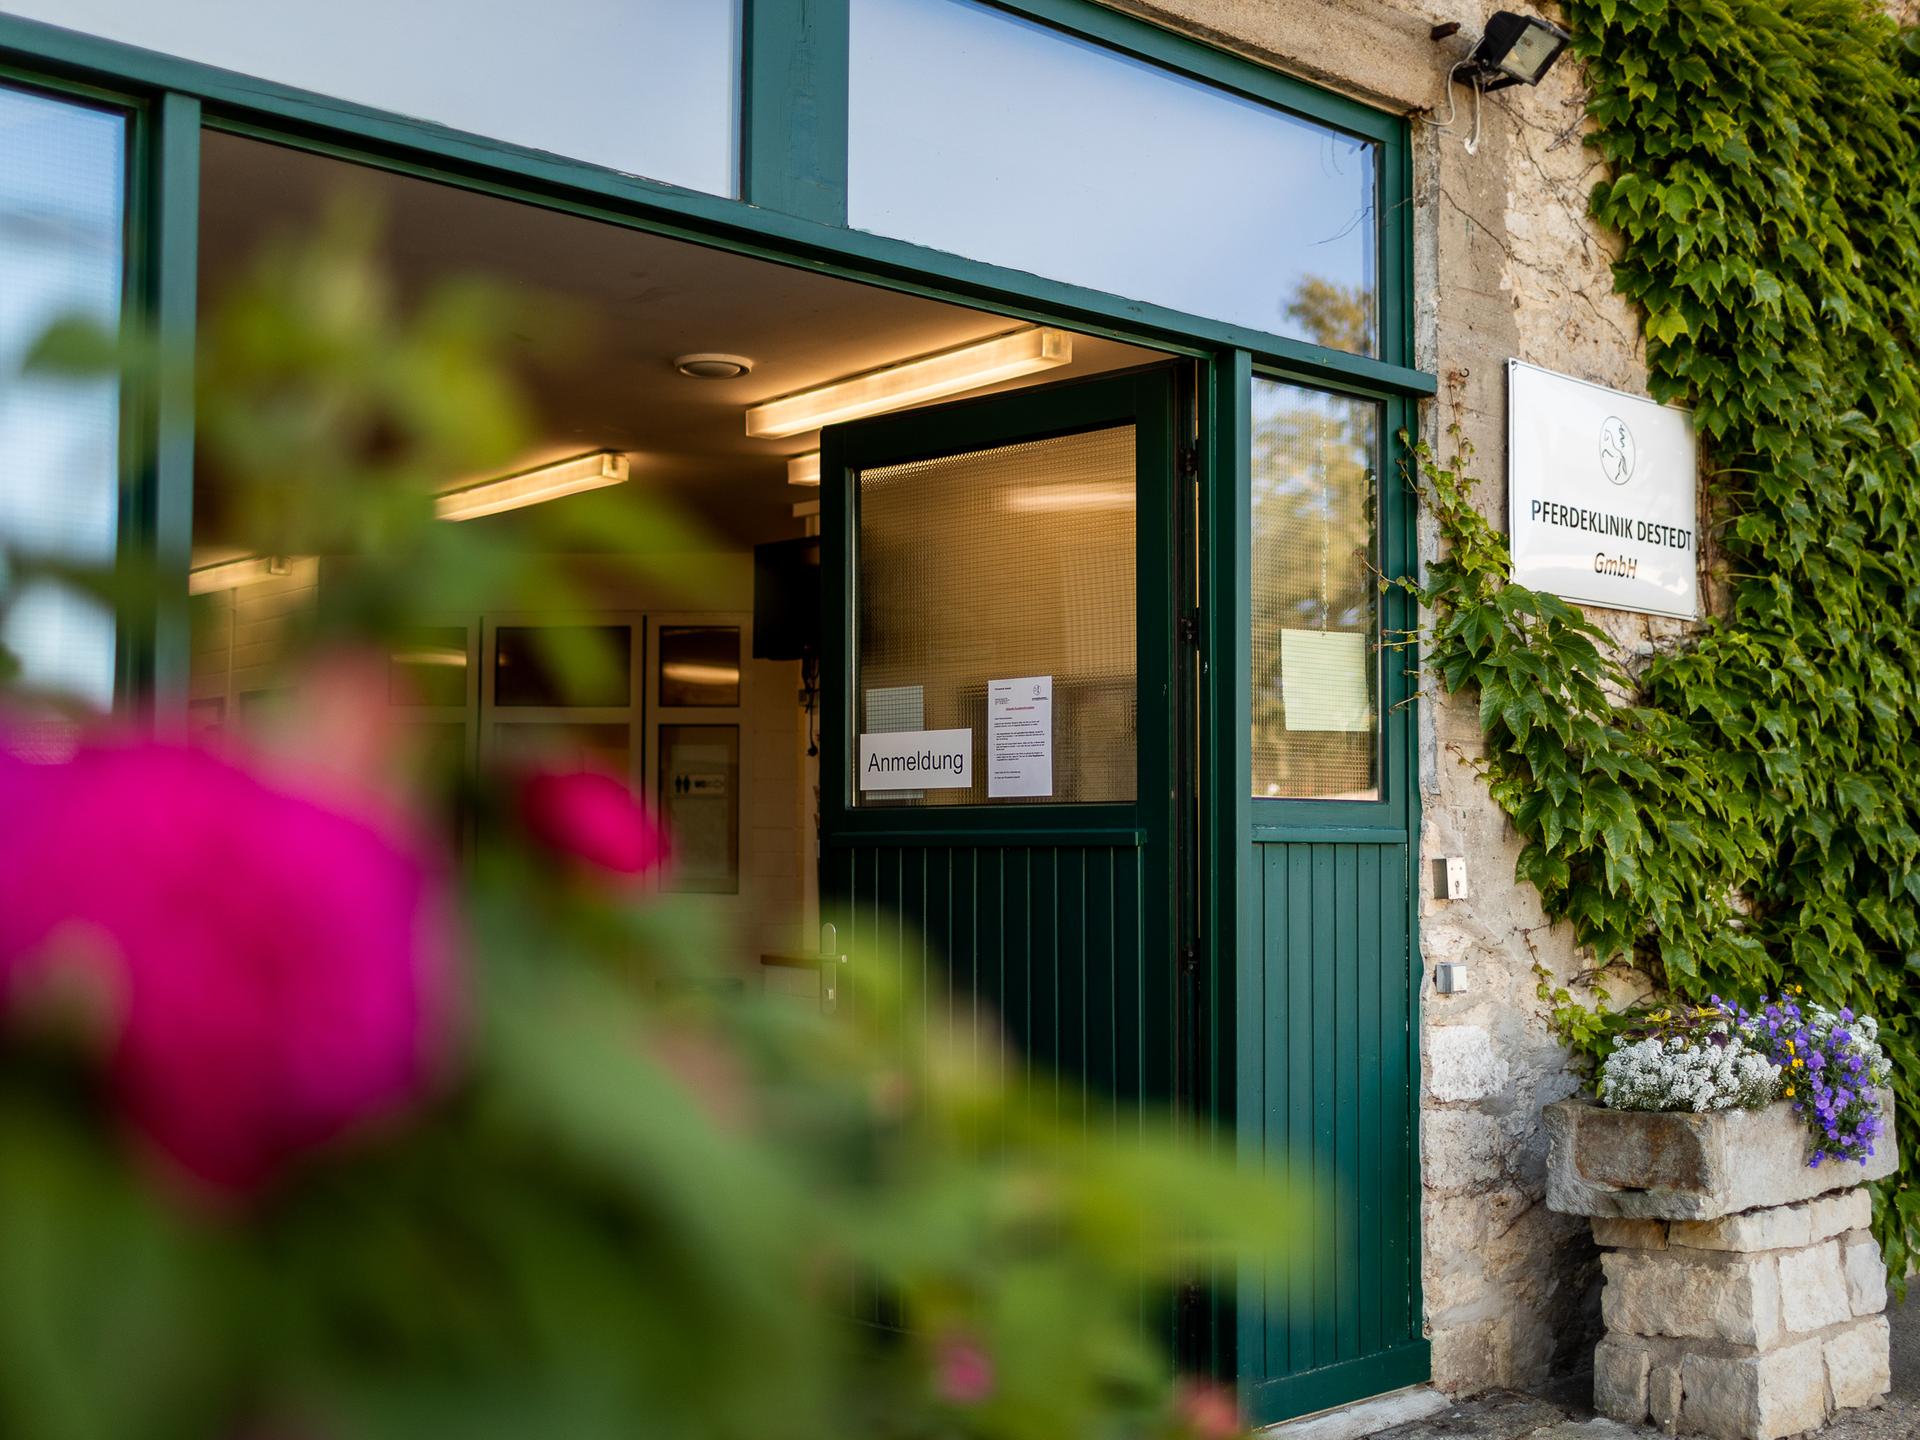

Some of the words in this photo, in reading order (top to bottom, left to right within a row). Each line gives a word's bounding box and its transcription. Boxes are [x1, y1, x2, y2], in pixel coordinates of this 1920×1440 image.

[1531, 500, 1633, 539] PFERDEKLINIK
[1637, 521, 1691, 550] DESTEDT
[1594, 552, 1637, 579] GmbH
[868, 750, 963, 774] Anmeldung
